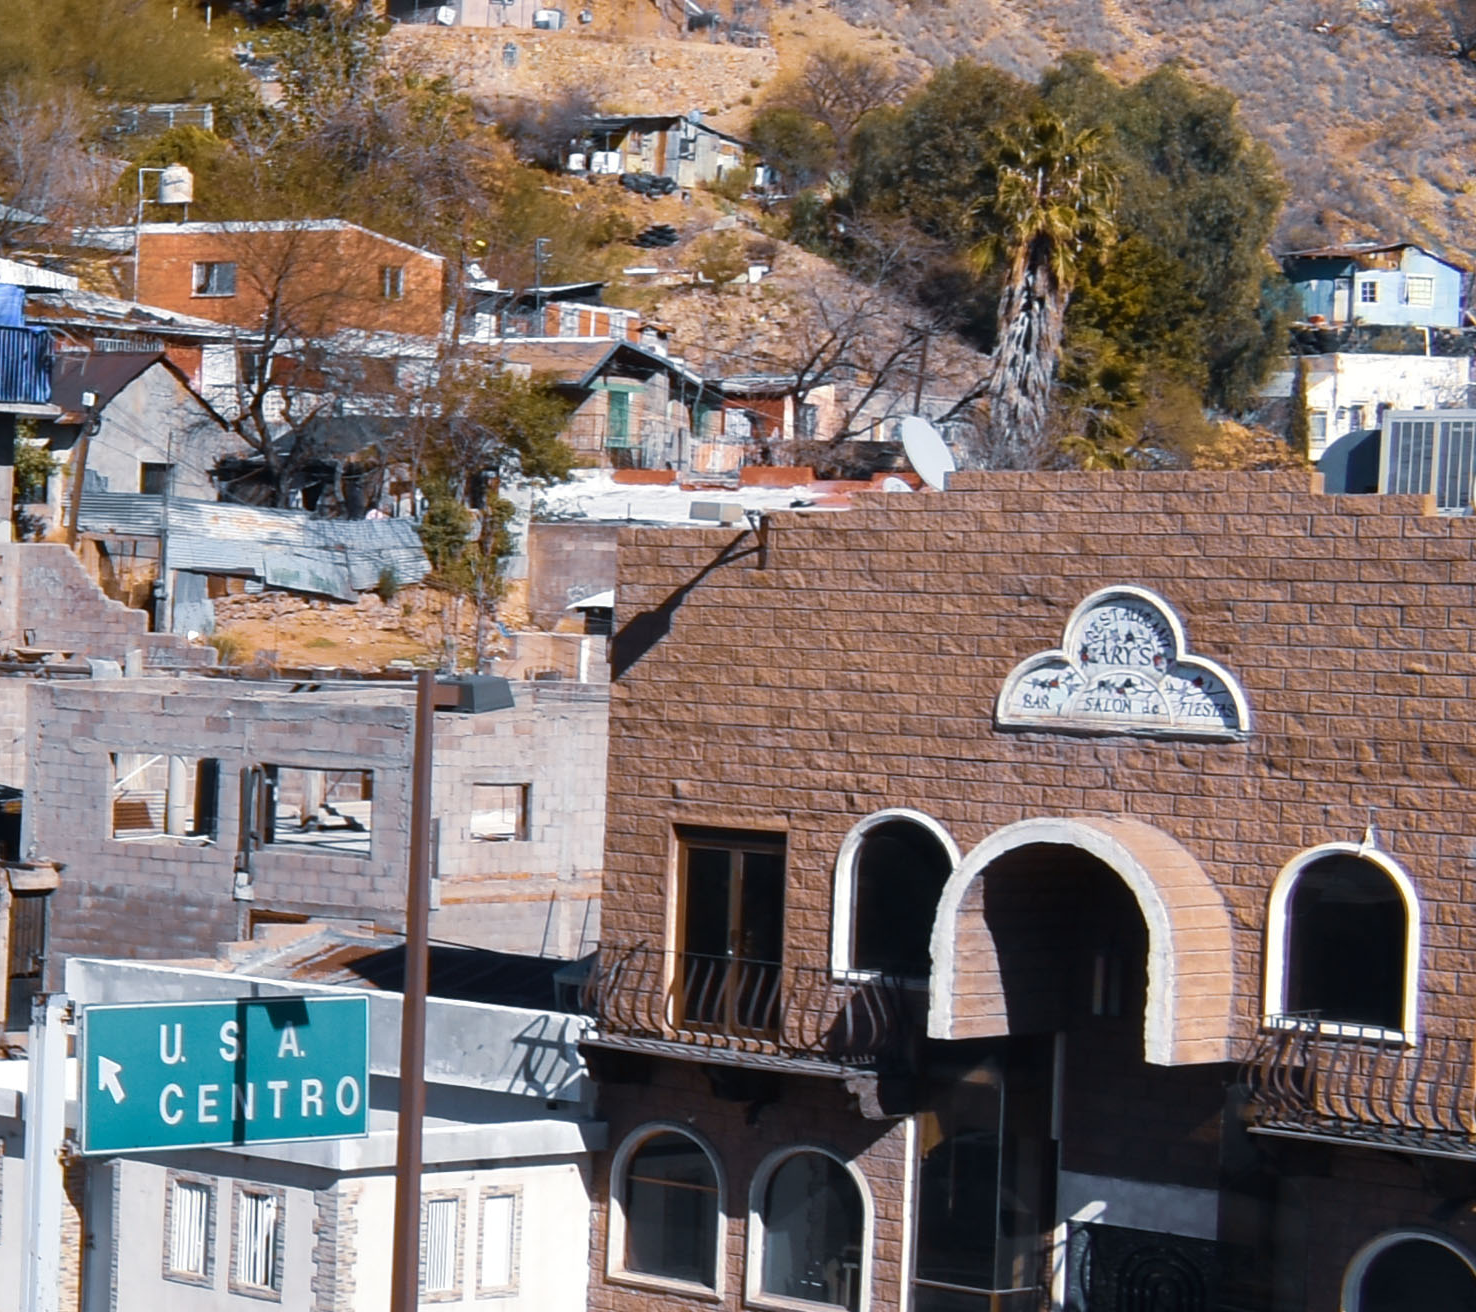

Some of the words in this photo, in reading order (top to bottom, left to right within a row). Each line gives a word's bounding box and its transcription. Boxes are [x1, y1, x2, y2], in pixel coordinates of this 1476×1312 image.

[1023, 694, 1050, 709] BAR
[1083, 696, 1132, 714] SALON
[1179, 701, 1236, 718] FIESTAS
[159, 1023, 187, 1065] U.
[159, 1075, 360, 1126] CENTRO
